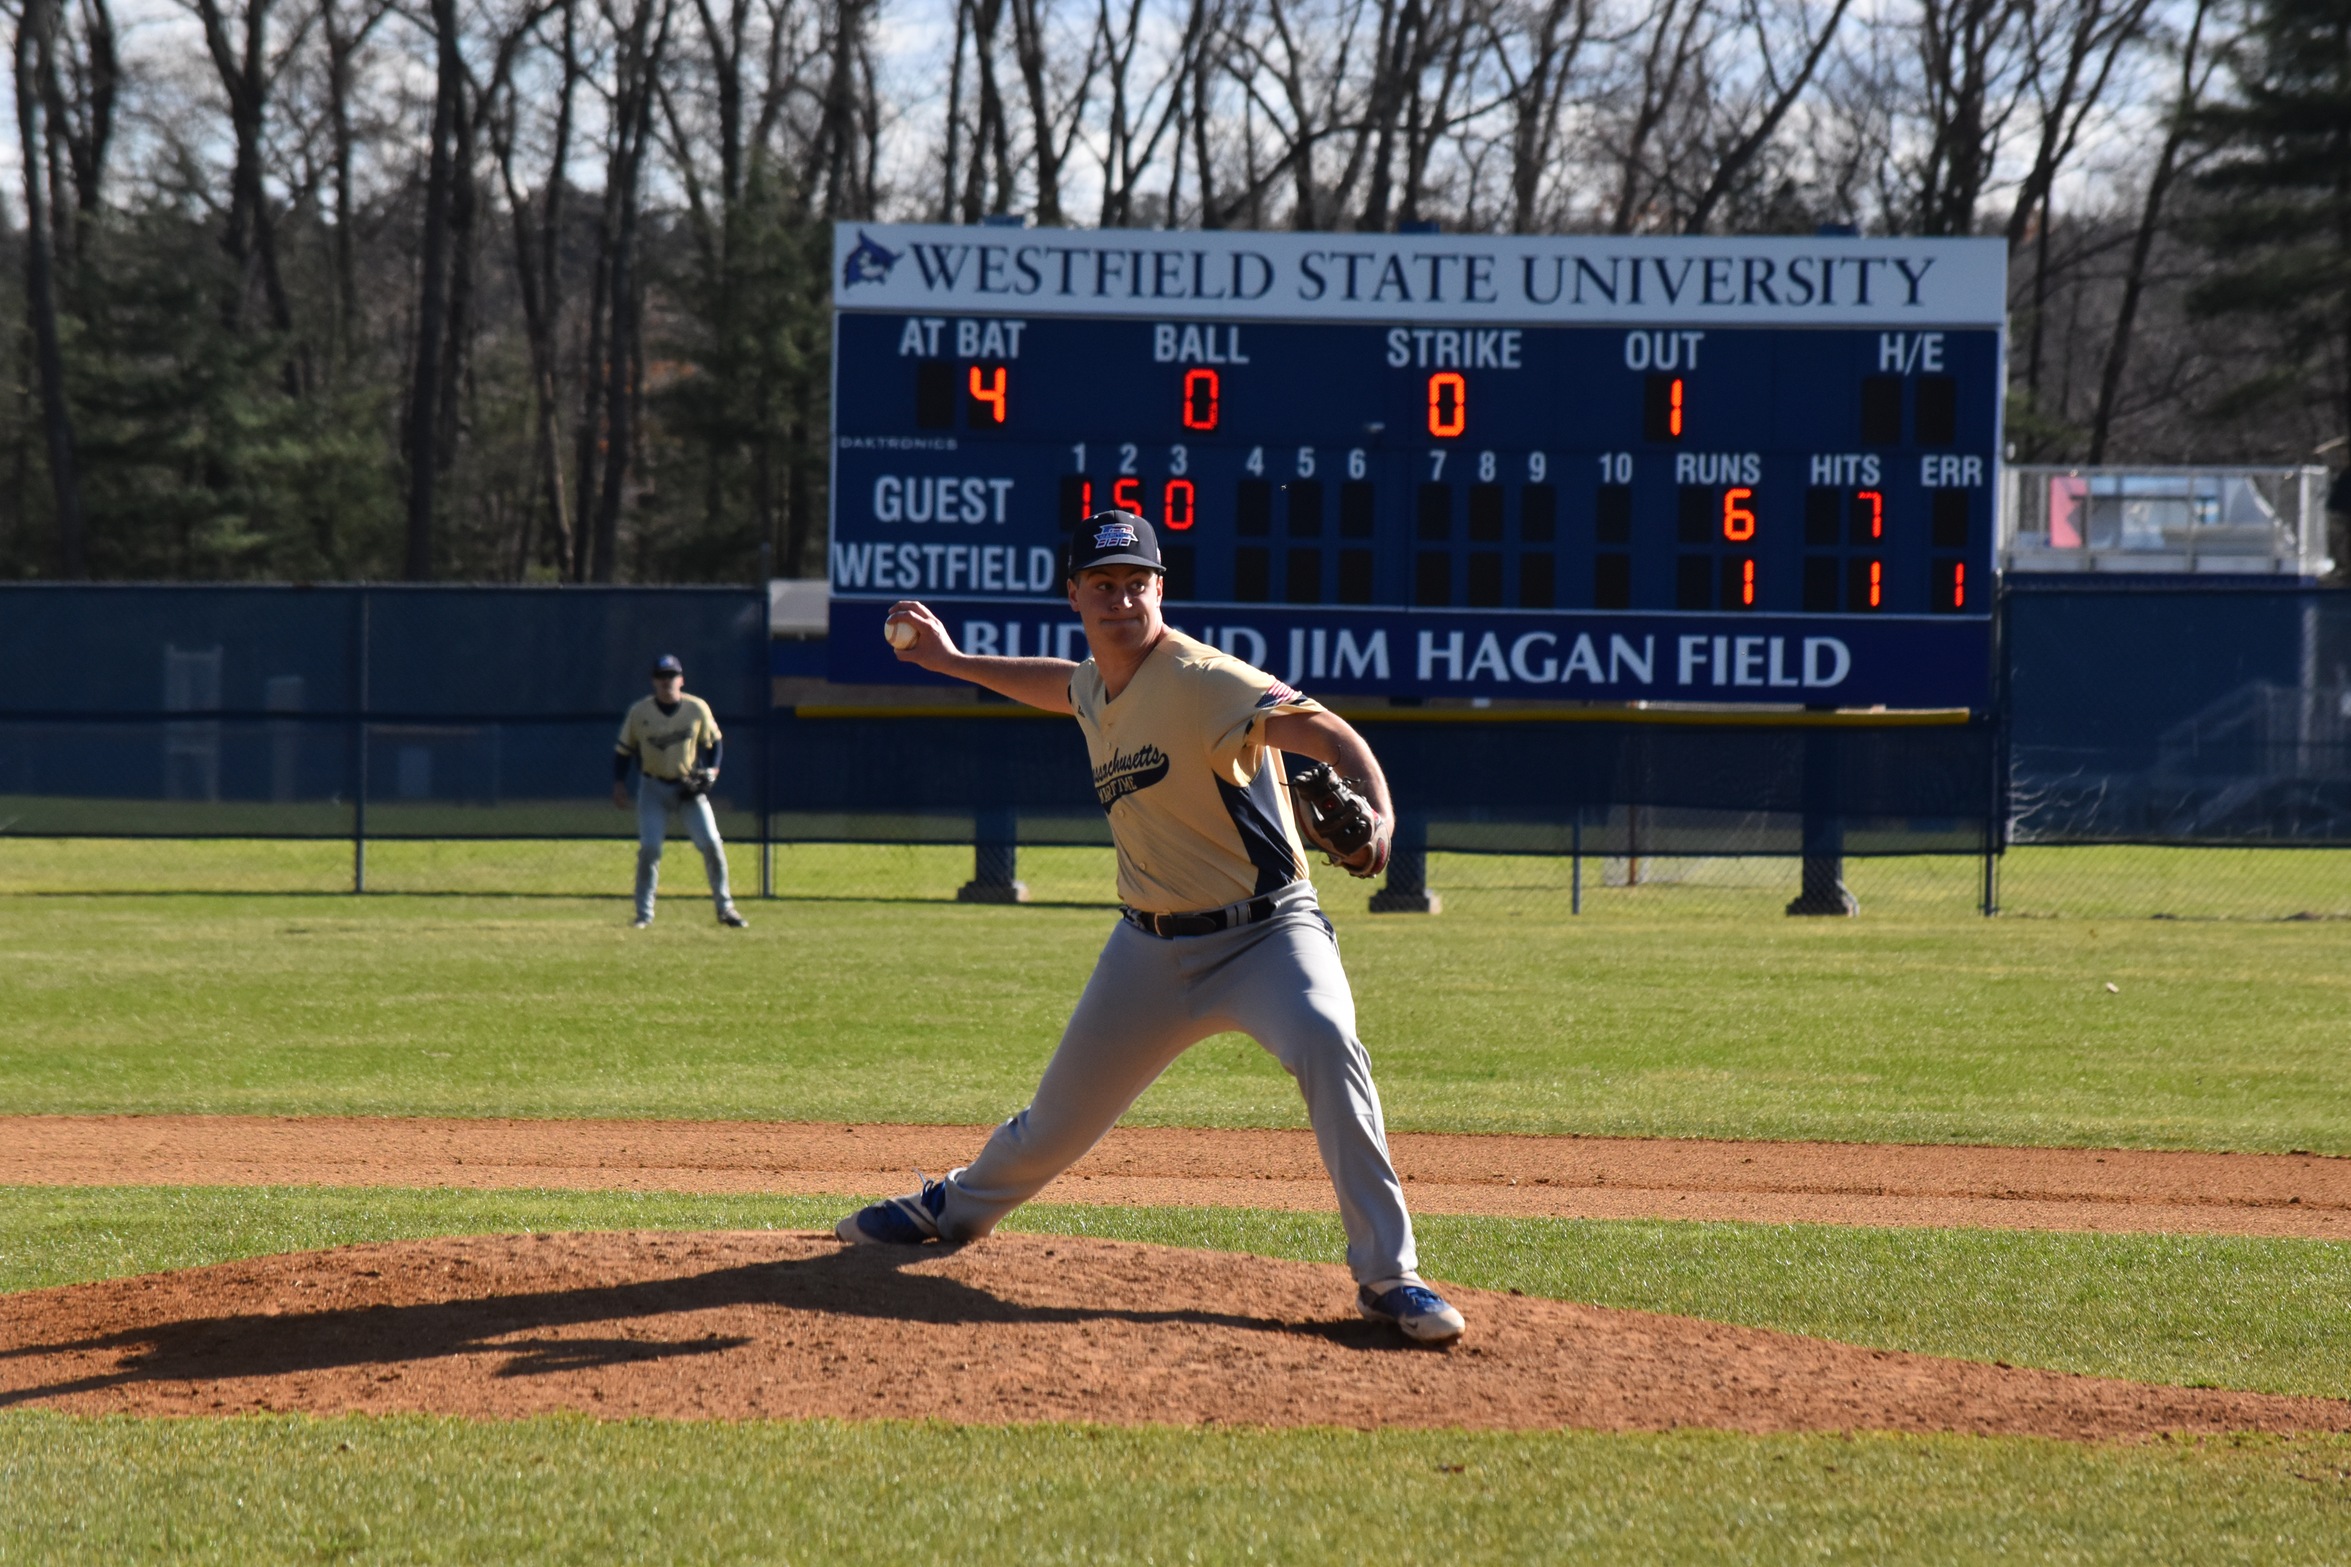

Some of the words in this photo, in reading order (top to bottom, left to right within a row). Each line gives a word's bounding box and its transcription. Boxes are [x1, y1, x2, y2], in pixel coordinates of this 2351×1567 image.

[910, 243, 1275, 300] WESTFIELD
[1299, 250, 1496, 303] STATE
[1523, 255, 1935, 306] UNIVERSITY
[900, 318, 946, 357] AT
[957, 319, 1027, 358] BAT
[1154, 324, 1250, 364] BALL
[1387, 328, 1522, 369] STRIKE
[1625, 331, 1705, 371] OUT
[1879, 332, 1945, 376] H/E
[968, 366, 1007, 424] 4
[1182, 368, 1220, 431] 0
[1427, 372, 1467, 438] 0
[1670, 378, 1684, 437] 1
[839, 436, 958, 451] DAKTRONICS
[1072, 443, 1086, 474] 1
[1120, 443, 1138, 475] 2
[1170, 444, 1188, 476] 3
[1246, 446, 1265, 476] 4
[1297, 447, 1316, 478] 5
[1348, 448, 1366, 480] 6
[1429, 450, 1447, 481] 7
[1478, 451, 1496, 483] 8
[1528, 452, 1547, 483] 9
[1599, 452, 1633, 484] 10
[1676, 453, 1761, 485] RUNS
[1811, 454, 1881, 486] HITS
[1921, 455, 1983, 487] ERR
[874, 475, 1015, 524] GUEST
[1164, 479, 1195, 530] 0
[1723, 487, 1756, 541] 6
[1857, 491, 1882, 538] 7
[833, 541, 1055, 591] WESTFIELD
[1742, 558, 1755, 605] 1
[1868, 560, 1882, 607] 1
[1954, 562, 1966, 607] 1
[1286, 627, 1391, 686] JIM
[1417, 629, 1656, 684] HAGAN
[1678, 635, 1851, 689] FIELD
